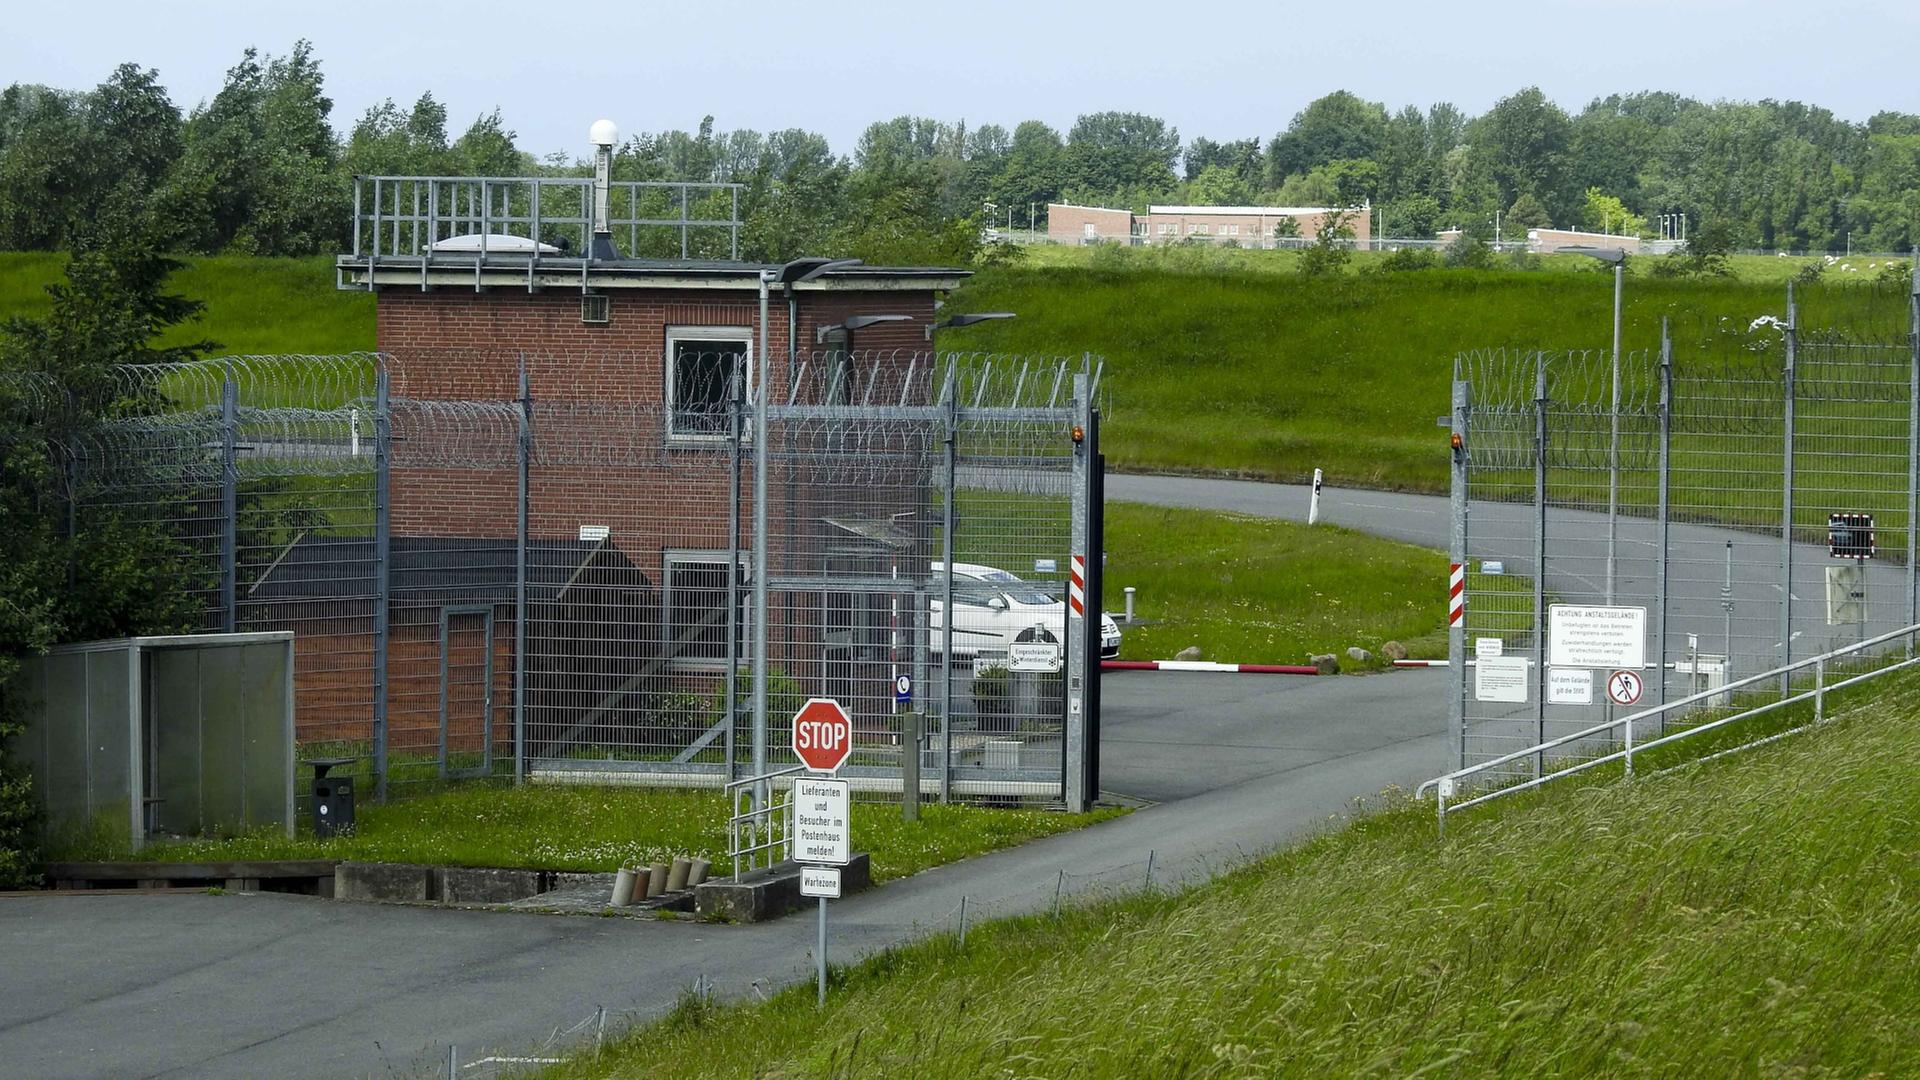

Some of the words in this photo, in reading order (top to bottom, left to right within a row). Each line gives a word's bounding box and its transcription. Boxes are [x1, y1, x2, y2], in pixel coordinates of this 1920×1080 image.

[1557, 610, 1582, 618] ACHTUNG
[799, 721, 846, 750] STOP
[802, 785, 840, 797] Lieferanten
[815, 801, 827, 811] und
[800, 814, 830, 826] Besucher
[834, 816, 842, 827] im
[801, 829, 840, 841] Postenhaus
[807, 845, 834, 856] melden!
[804, 876, 836, 887] Wartezone
